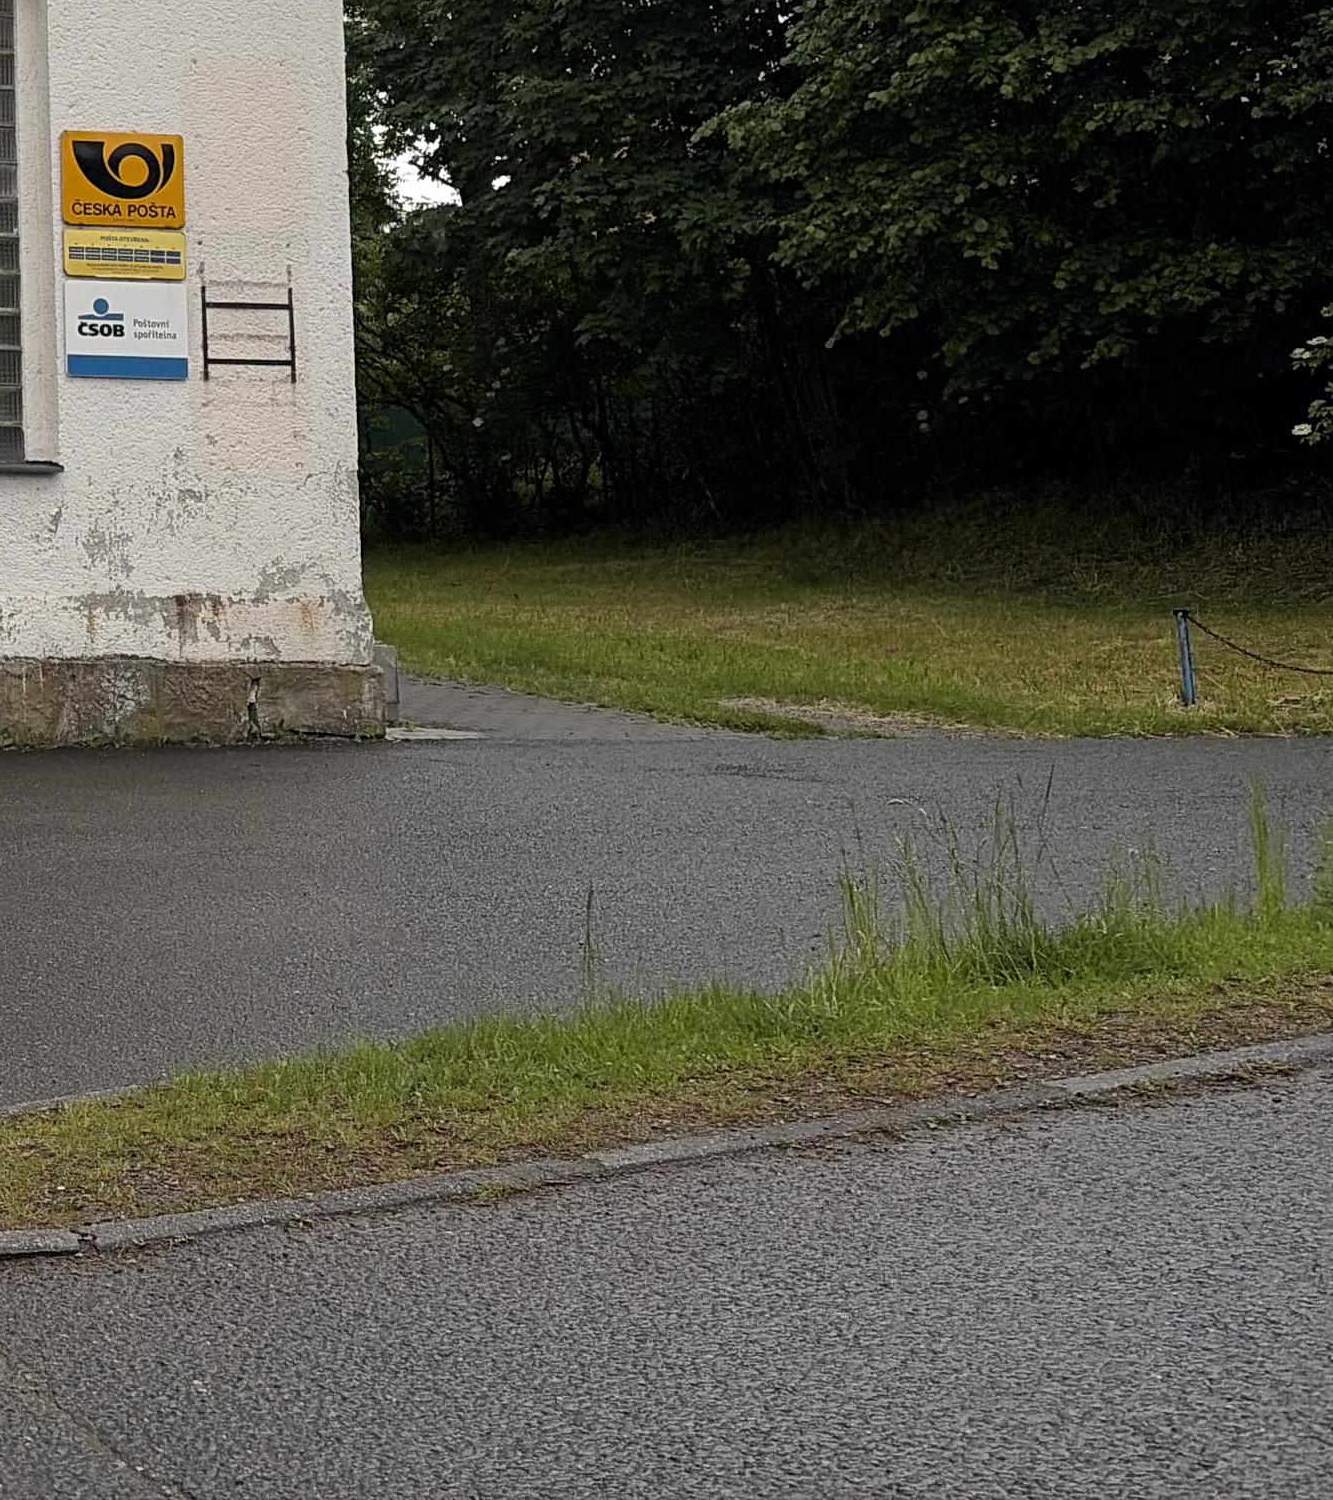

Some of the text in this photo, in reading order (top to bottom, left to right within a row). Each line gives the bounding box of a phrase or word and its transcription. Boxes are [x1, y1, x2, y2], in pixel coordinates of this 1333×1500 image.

[127, 202, 176, 218] POŠTA
[78, 321, 125, 337] ČSOB
[133, 319, 170, 328] Poštovní
[133, 331, 177, 340] spořitelna
